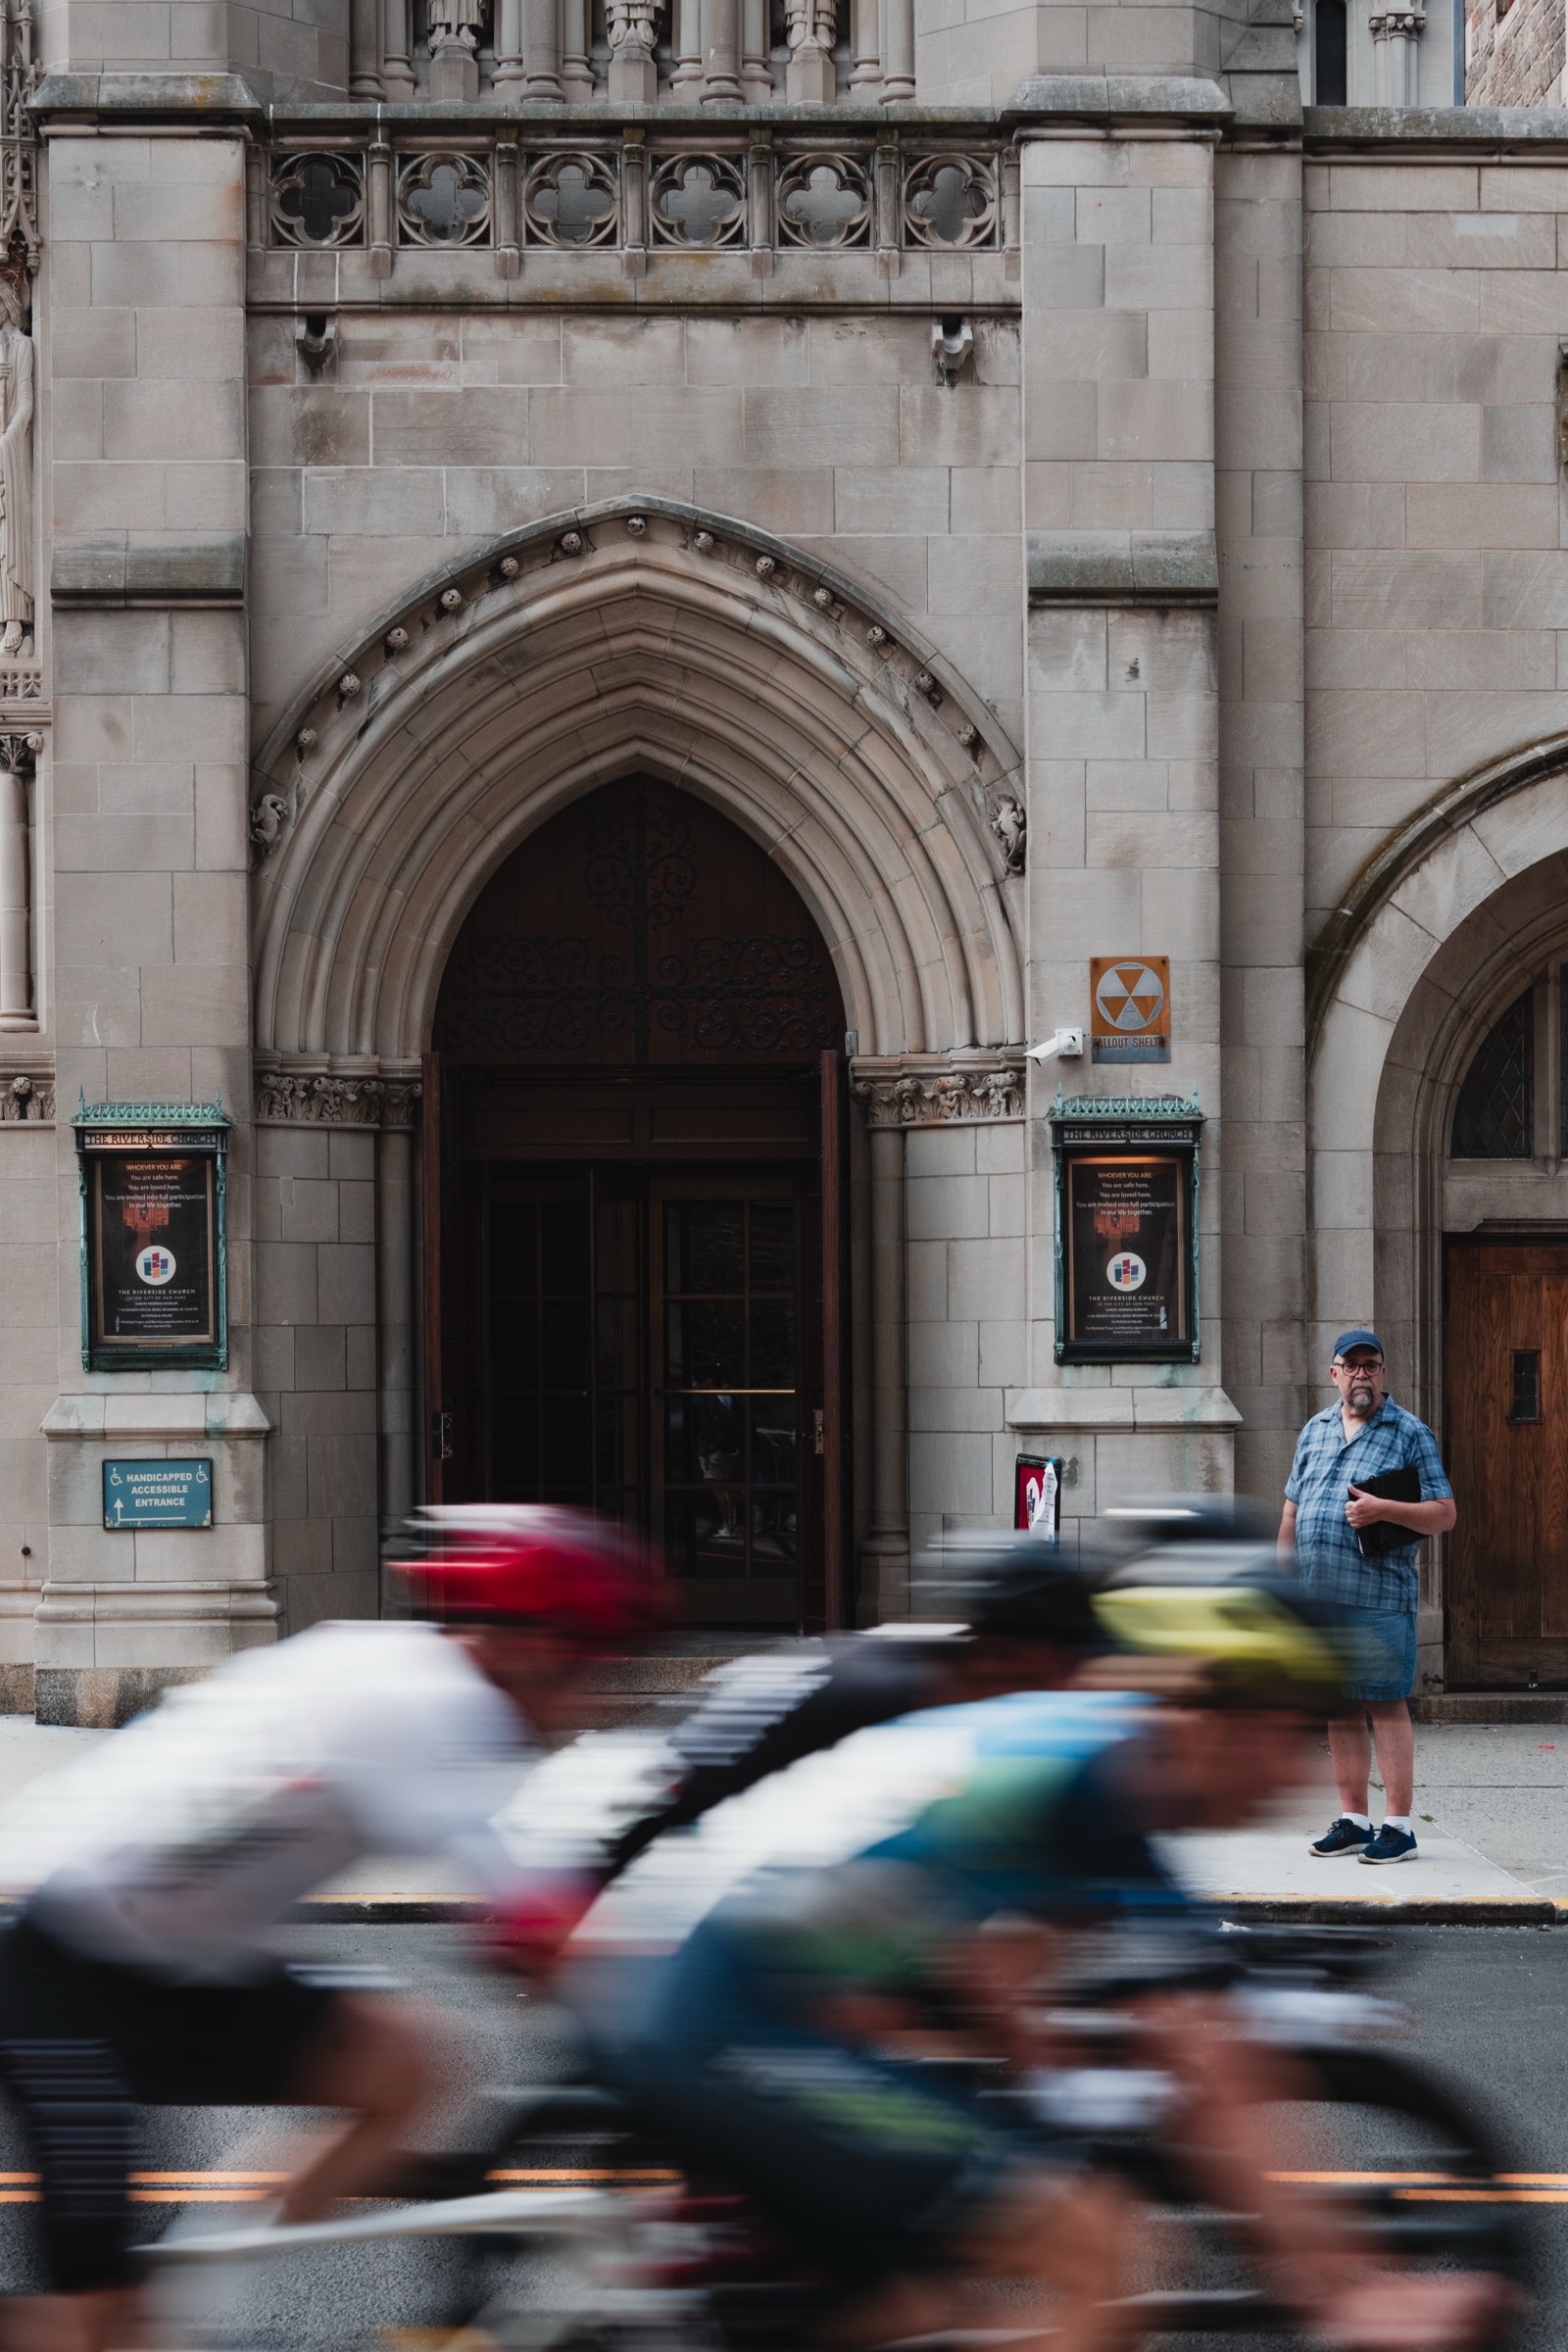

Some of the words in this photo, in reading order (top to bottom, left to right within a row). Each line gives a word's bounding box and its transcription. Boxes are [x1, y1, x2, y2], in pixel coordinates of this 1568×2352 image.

[87, 1134, 108, 1144] THE
[112, 1134, 169, 1144] RIVERSIDE
[171, 1134, 213, 1144] CHURCH
[1067, 1130, 1087, 1139] THE
[1091, 1130, 1147, 1139] RIVERSIDE
[1149, 1130, 1190, 1139] CHURCH
[126, 1473, 192, 1483] HANDICAPPED
[131, 1485, 188, 1494] ACCESSIBLE
[135, 1497, 185, 1507] ENTRANCE
